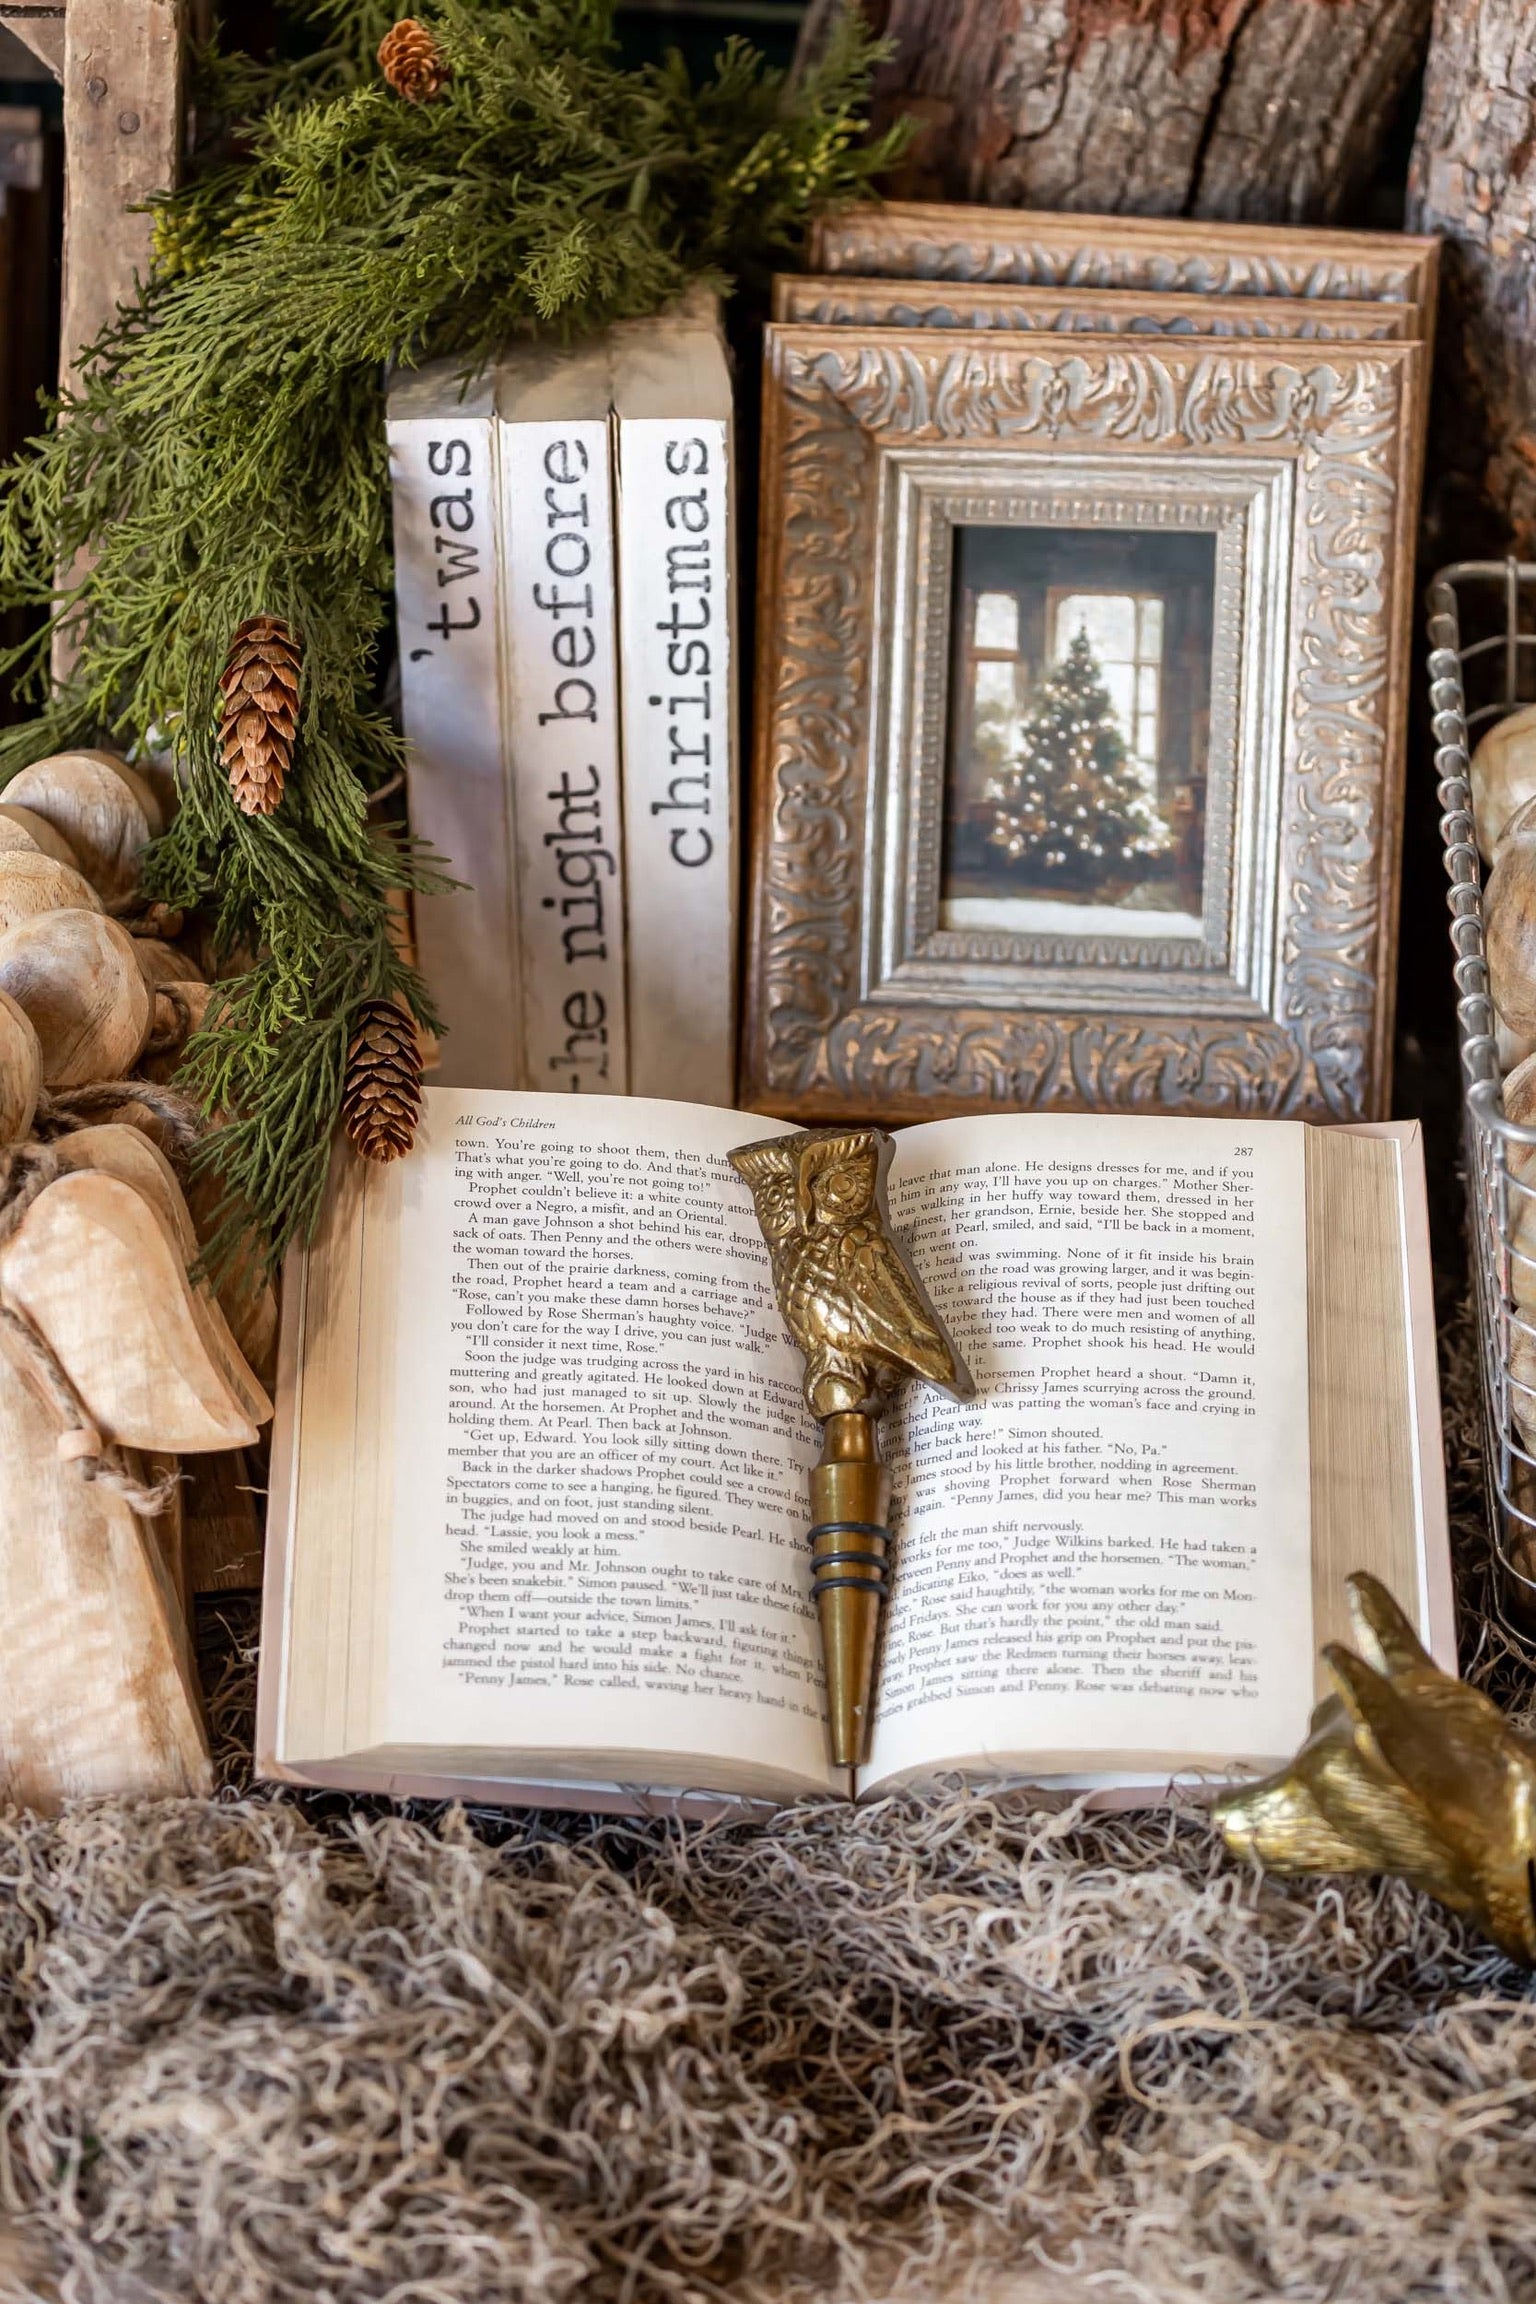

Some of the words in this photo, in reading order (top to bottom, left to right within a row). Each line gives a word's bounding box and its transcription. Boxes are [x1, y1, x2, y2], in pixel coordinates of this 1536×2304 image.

[532, 440, 598, 727] before
[648, 438, 713, 868] christmas
[541, 765, 616, 961] night
[548, 990, 608, 1092] he
[454, 1114, 474, 1125] All
[475, 1116, 507, 1127] God's
[509, 1117, 556, 1129] Children
[455, 1139, 489, 1149] town.
[494, 1137, 536, 1151] You're
[540, 1140, 574, 1155] going
[579, 1144, 592, 1153] to
[596, 1142, 630, 1155] shoot
[635, 1144, 669, 1160] them,
[674, 1148, 700, 1163] then
[705, 1152, 732, 1169] dum
[1233, 1146, 1253, 1156] 287
[454, 1166, 473, 1180] ing
[476, 1167, 503, 1179] with
[506, 1172, 542, 1183] anger.
[587, 1172, 625, 1186] you're
[628, 1177, 648, 1186] not
[651, 1177, 685, 1192] going
[898, 1174, 926, 1189] leave
[928, 1168, 951, 1182] that
[955, 1166, 981, 1176] man
[984, 1161, 1020, 1173] alone.
[1025, 1160, 1044, 1171] He
[1047, 1160, 1092, 1174] designs
[1096, 1160, 1140, 1173] dresses
[1143, 1162, 1162, 1174] for
[1165, 1167, 1188, 1176] me,
[1191, 1165, 1215, 1177] and
[1218, 1166, 1229, 1177] if
[1231, 1170, 1254, 1180] you
[453, 1197, 492, 1209] crowd
[494, 1201, 522, 1210] over
[525, 1202, 532, 1211] a
[535, 1200, 577, 1214] Negro,
[581, 1205, 588, 1213] a
[591, 1202, 629, 1216] misfit,
[632, 1204, 655, 1216] and
[658, 1209, 673, 1218] an
[676, 1208, 727, 1226] Oriental.
[912, 1214, 946, 1229] finest,
[950, 1208, 971, 1220] her
[974, 1203, 1034, 1220] grandson,
[1038, 1203, 1075, 1215] Ernie,
[1080, 1203, 1119, 1216] beside
[1123, 1204, 1146, 1216] her.
[1151, 1206, 1174, 1218] She
[1177, 1209, 1227, 1222] stopped
[1231, 1210, 1254, 1222] and
[452, 1226, 479, 1238] sack
[482, 1227, 496, 1239] of
[498, 1231, 526, 1241] oats.
[529, 1229, 562, 1242] Then
[565, 1231, 603, 1246] Penny
[606, 1232, 629, 1245] and
[632, 1233, 652, 1246] the
[654, 1236, 691, 1251] others
[694, 1243, 722, 1255] were
[725, 1245, 768, 1266] shoving
[935, 1251, 963, 1267] head
[968, 1252, 991, 1261] was
[995, 1247, 1061, 1261] swimming.
[1067, 1247, 1101, 1259] None
[1106, 1247, 1120, 1259] of
[1124, 1248, 1133, 1260] it
[1138, 1248, 1152, 1260] fit
[1157, 1250, 1194, 1263] inside
[1199, 1251, 1217, 1264] his
[1222, 1252, 1254, 1265] brain
[466, 1257, 499, 1270] Then
[502, 1262, 523, 1271] out
[527, 1259, 542, 1272] of
[545, 1260, 565, 1273] the
[568, 1262, 609, 1276] prairie
[612, 1262, 670, 1279] darkness,
[673, 1271, 718, 1287] coming
[721, 1274, 749, 1290] from
[752, 1280, 771, 1295] the
[494, 1289, 524, 1302] can't
[527, 1294, 550, 1304] you
[553, 1291, 586, 1304] make
[589, 1292, 621, 1305] these
[624, 1293, 659, 1307] damn
[662, 1296, 700, 1312] horses
[492, 1336, 545, 1349] consider
[548, 1338, 557, 1349] it
[560, 1341, 587, 1350] next
[591, 1339, 622, 1353] time,
[967, 1338, 987, 1351] the
[991, 1339, 1026, 1349] same.
[1031, 1335, 1082, 1350] Prophet
[1087, 1335, 1124, 1348] shook
[1130, 1336, 1148, 1349] his
[1153, 1337, 1186, 1351] head.
[1192, 1340, 1212, 1353] He
[1216, 1343, 1255, 1355] would
[449, 1367, 510, 1381] muttering
[514, 1367, 537, 1380] and
[541, 1369, 583, 1384] greatly
[587, 1370, 639, 1384] agitated.
[644, 1371, 663, 1385] He
[667, 1373, 708, 1390] looked
[711, 1379, 744, 1396] down
[748, 1390, 759, 1399] at
[762, 1388, 805, 1412] Edward
[994, 1381, 1039, 1395] Chrissy
[1041, 1381, 1079, 1395] James
[1082, 1382, 1139, 1396] scurrying
[1143, 1386, 1181, 1396] across
[1184, 1385, 1205, 1397] the
[1207, 1388, 1255, 1400] ground.
[498, 1433, 519, 1444] up,
[523, 1430, 576, 1444] Edward.
[582, 1432, 607, 1444] You
[612, 1432, 640, 1445] look
[644, 1434, 669, 1450] silly
[672, 1438, 710, 1455] sitting
[714, 1442, 747, 1459] down
[751, 1448, 783, 1467] there.
[786, 1457, 805, 1475] Try
[913, 1440, 932, 1453] her
[935, 1432, 962, 1447] back
[1008, 1427, 1047, 1439] Simon
[1050, 1426, 1103, 1438] shouted.
[445, 1492, 458, 1503] in
[516, 1494, 540, 1506] and
[543, 1498, 560, 1507] on
[596, 1496, 618, 1510] just
[622, 1497, 675, 1514] standing
[919, 1530, 937, 1544] felt
[940, 1527, 959, 1540] the
[962, 1525, 988, 1536] man
[991, 1519, 1018, 1533] shift
[459, 1539, 484, 1553] She
[486, 1540, 528, 1554] smiled
[531, 1542, 574, 1558] weakly
[577, 1547, 589, 1556] at
